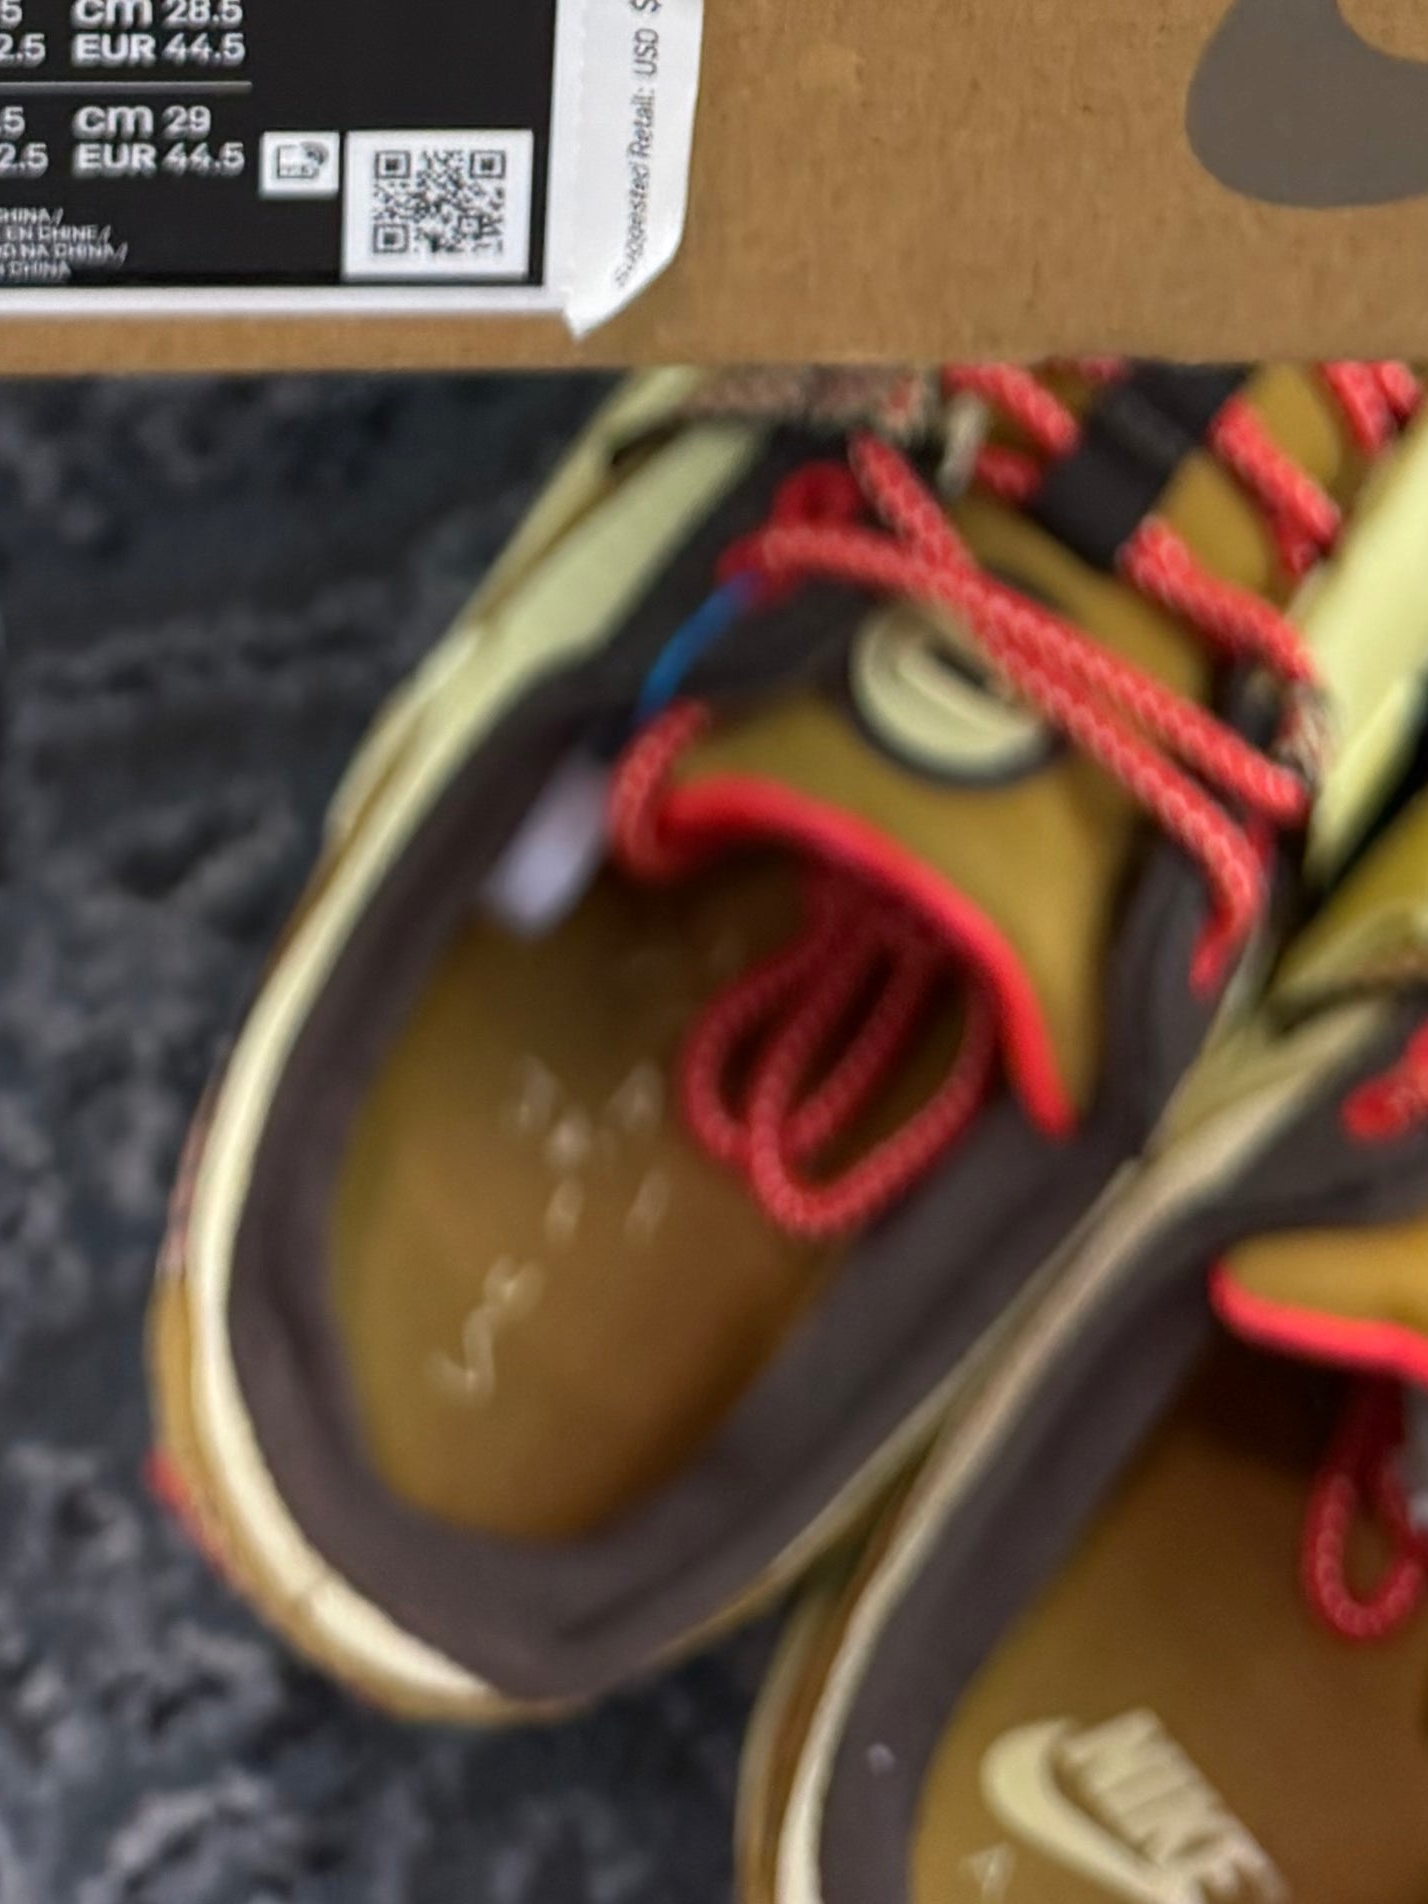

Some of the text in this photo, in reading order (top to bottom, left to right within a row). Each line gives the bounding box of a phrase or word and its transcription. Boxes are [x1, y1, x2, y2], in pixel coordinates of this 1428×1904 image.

[72, 33, 155, 66] EUR
[163, 32, 246, 66] 44.5
[634, 28, 660, 78] USD
[164, 105, 211, 138] 29
[74, 143, 157, 175] EUR
[162, 142, 246, 175] 44.5
